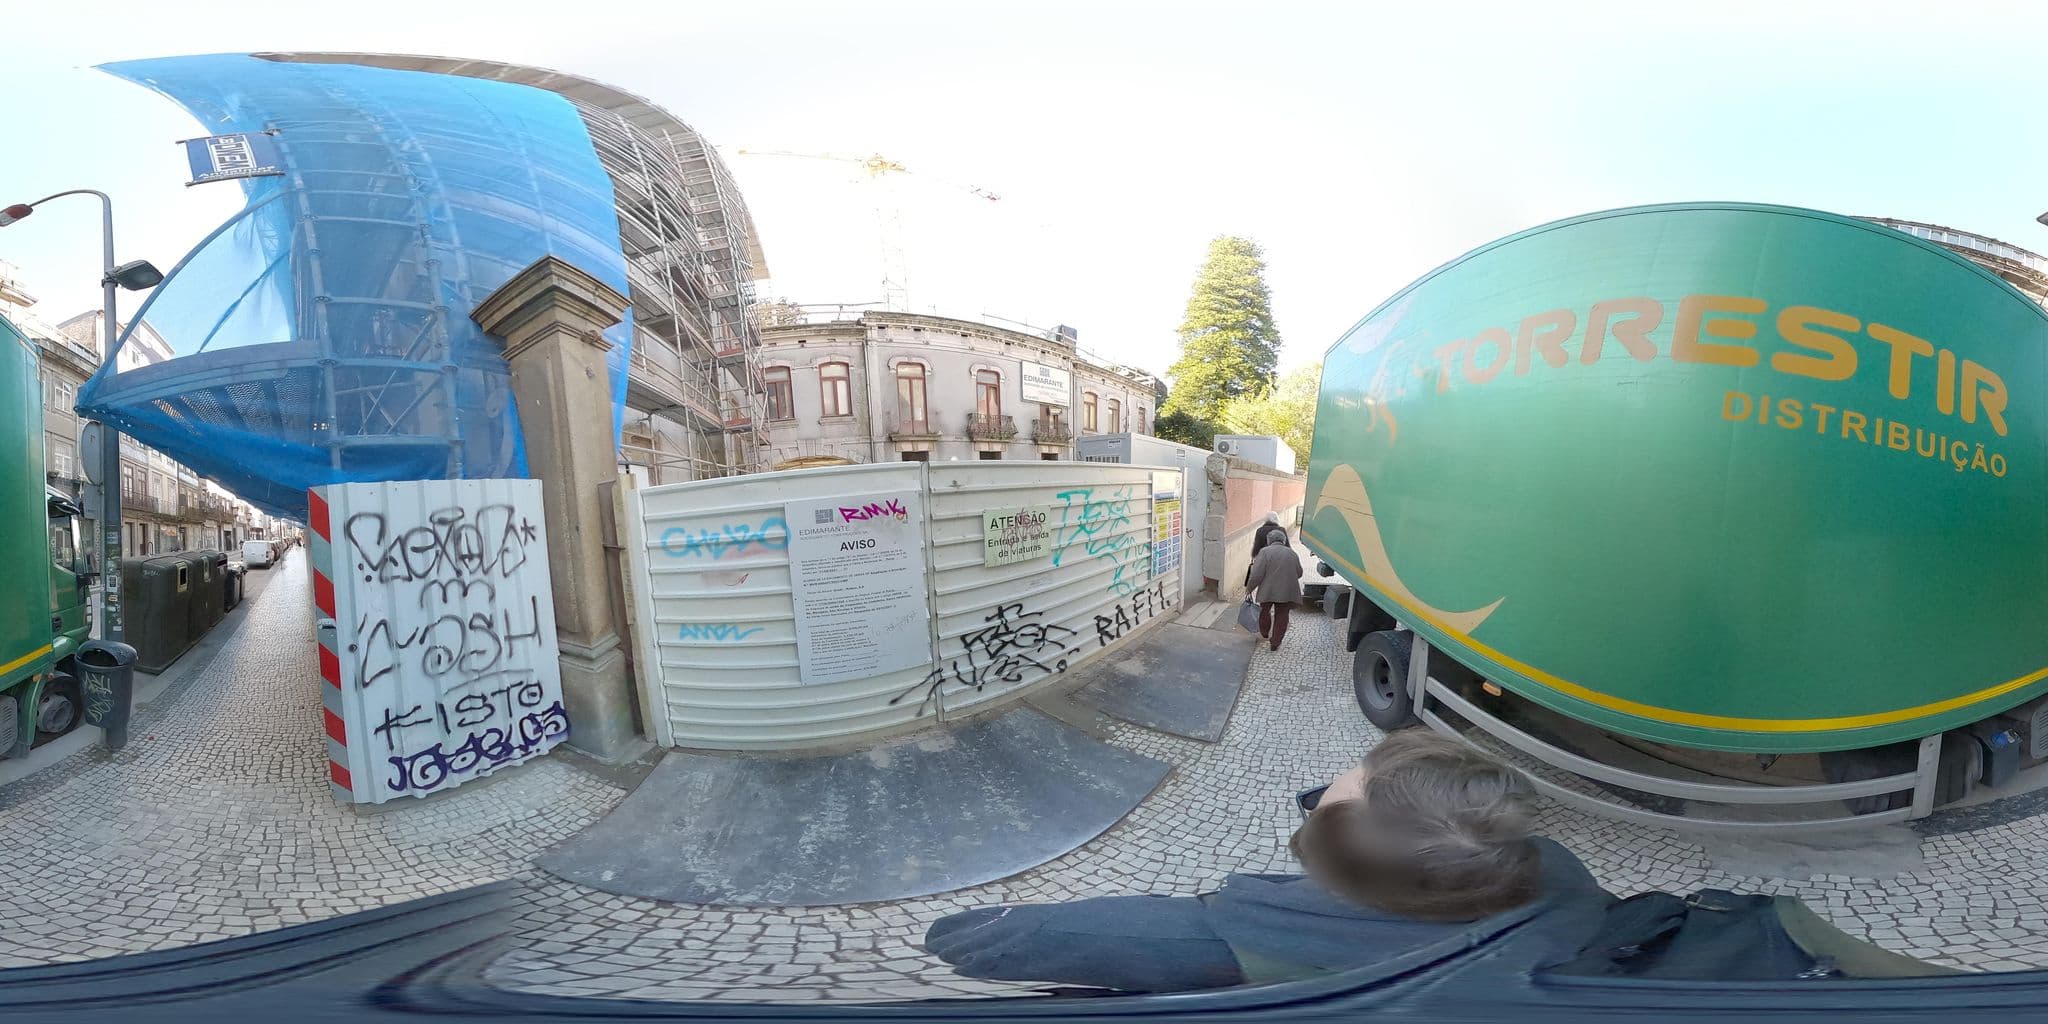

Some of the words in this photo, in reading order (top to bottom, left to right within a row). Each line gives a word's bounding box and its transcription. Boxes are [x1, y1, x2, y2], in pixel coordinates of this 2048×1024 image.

[1433, 294, 2009, 437] TORRESTIR
[1023, 374, 1064, 389] EDIMARANTE
[1720, 390, 2008, 478] DISTRIBUIÇÃO
[799, 525, 849, 537] EDIMARANTE
[840, 538, 876, 552] AVISO
[998, 549, 1009, 558] de
[1011, 544, 1042, 556] viaturas
